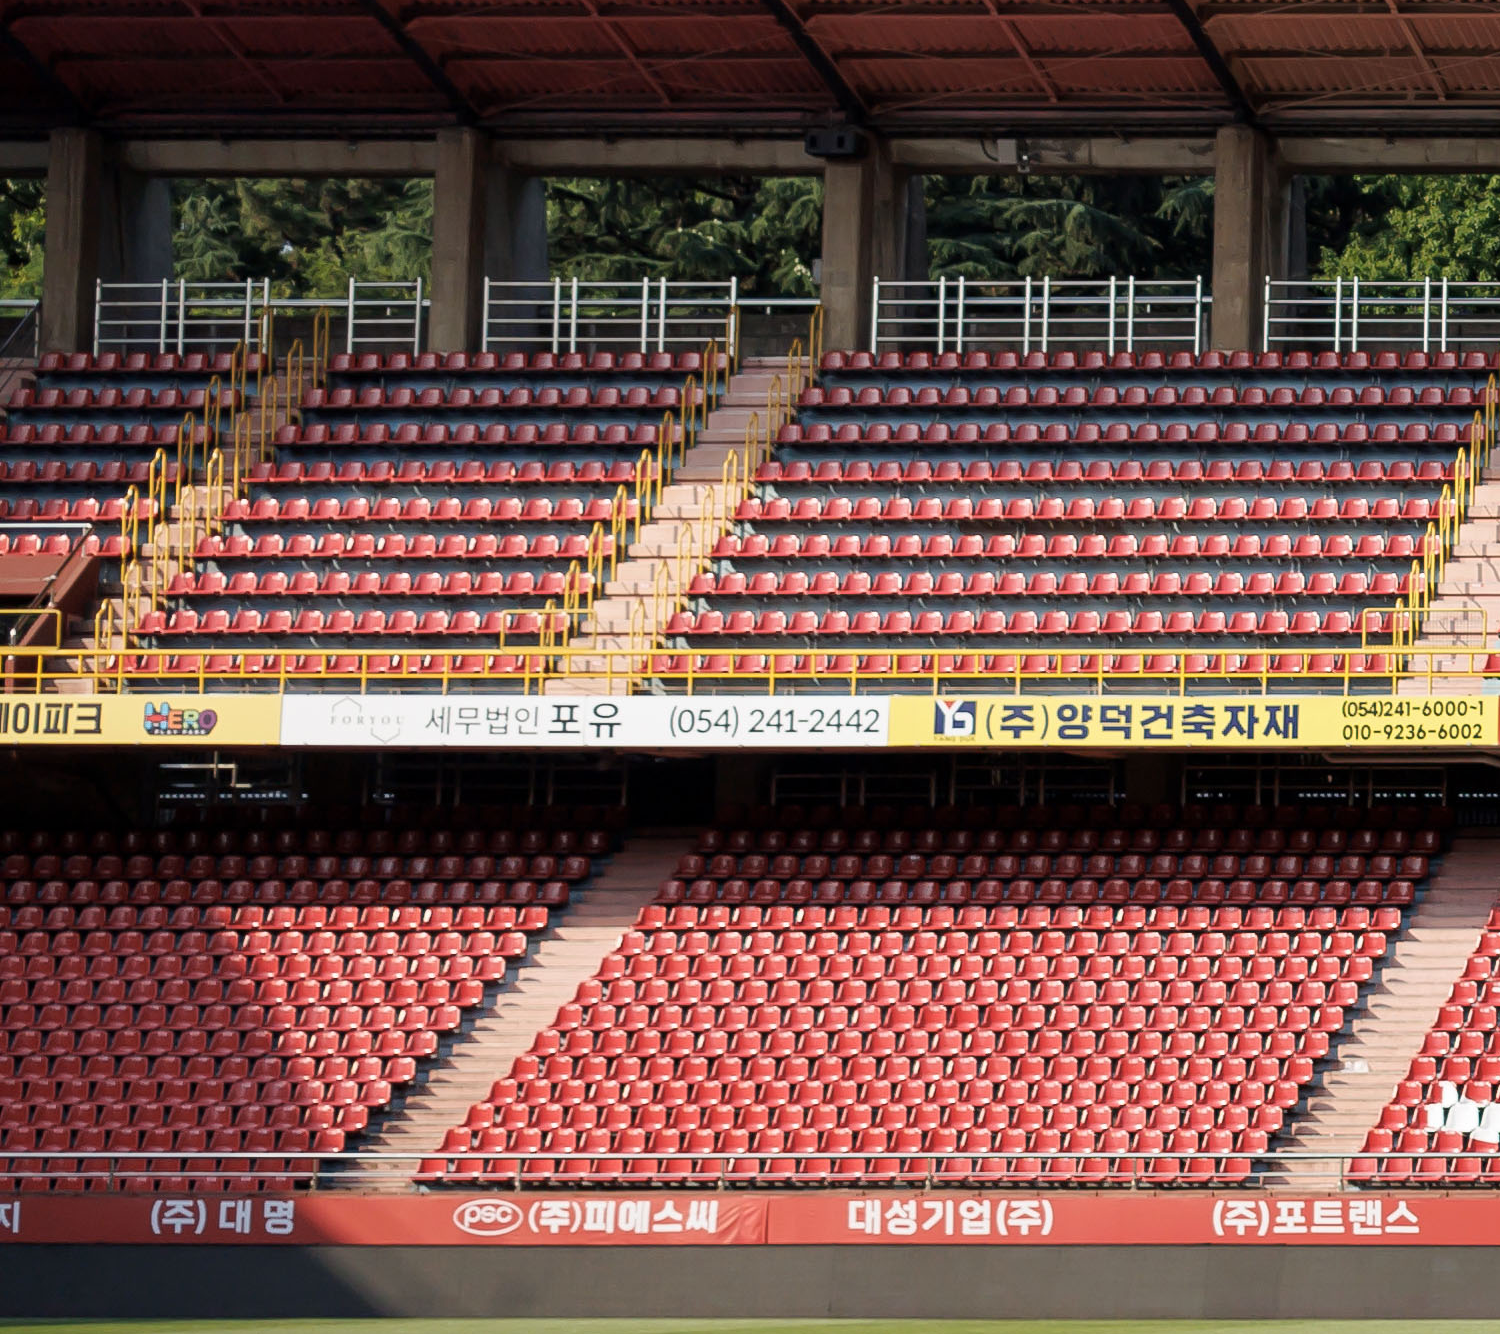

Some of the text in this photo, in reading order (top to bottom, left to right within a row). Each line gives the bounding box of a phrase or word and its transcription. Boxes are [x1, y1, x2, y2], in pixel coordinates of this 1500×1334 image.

[143, 701, 218, 730] HERO
[425, 703, 622, 738] 세무법인 포유
[669, 704, 880, 737] (054) 241-2442
[1342, 723, 1483, 741] 010-9236-6002
[528, 1199, 719, 1234] (주)피에스씨
[847, 1199, 1055, 1236] 대성기업(주)
[1212, 1199, 1420, 1236] (주)포트랜스
